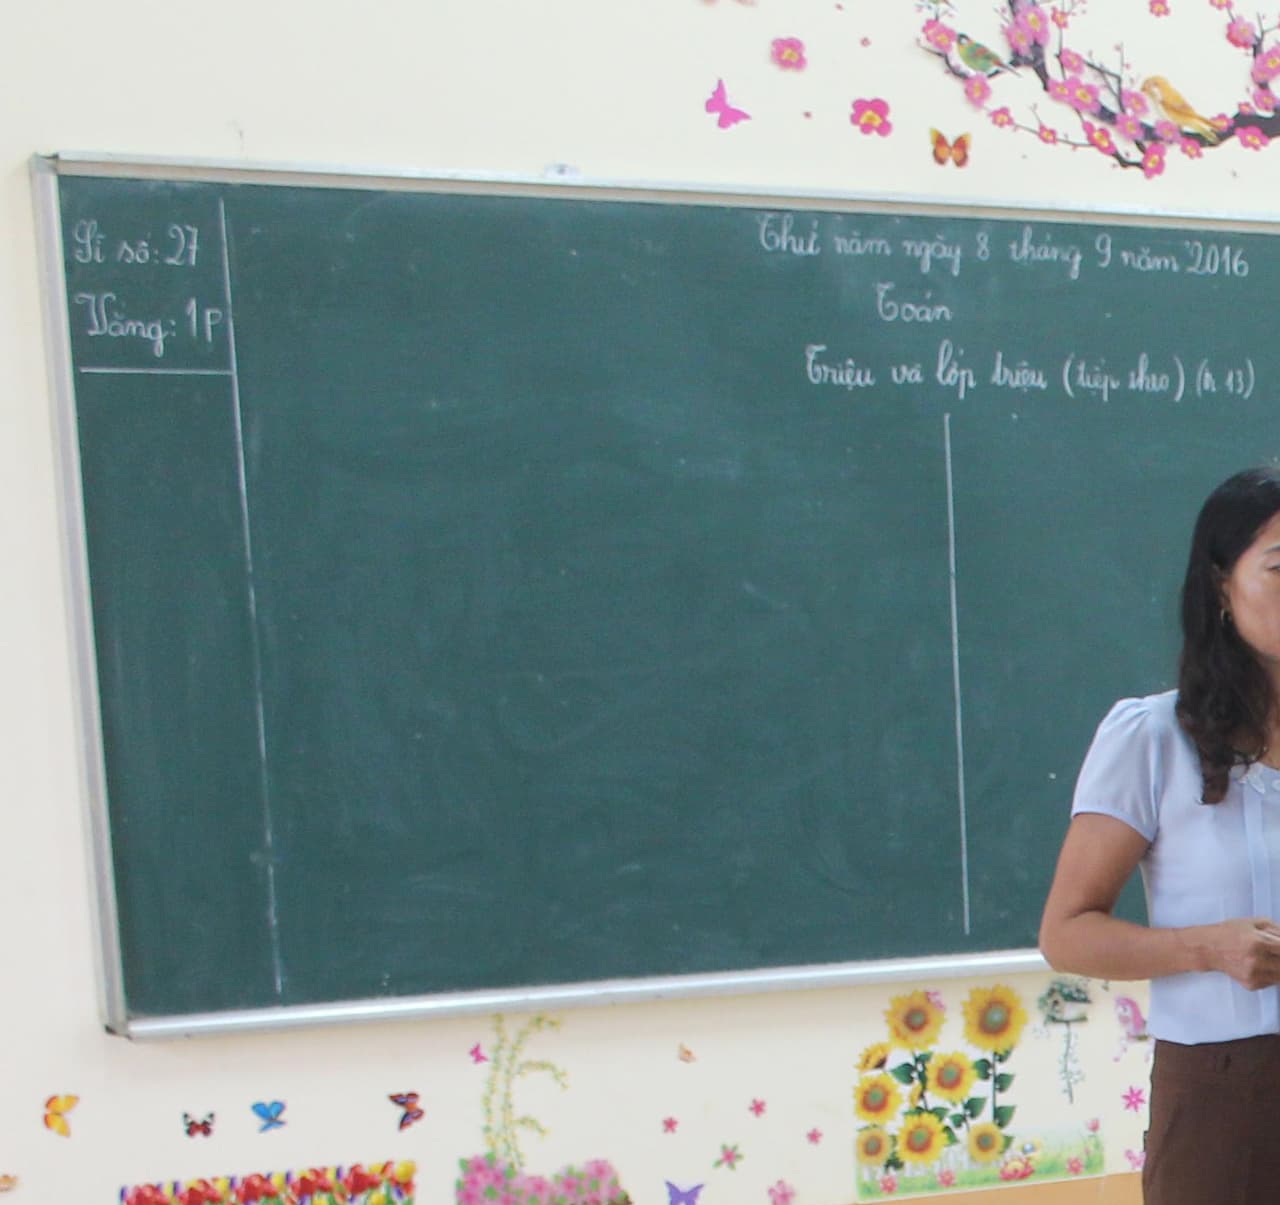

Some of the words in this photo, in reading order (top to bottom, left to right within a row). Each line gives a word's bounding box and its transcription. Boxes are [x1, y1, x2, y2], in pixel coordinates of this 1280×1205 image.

[164, 222, 199, 266] 27
[976, 231, 991, 262] 8
[1095, 232, 1112, 268] 9
[1184, 240, 1250, 278] 2016
